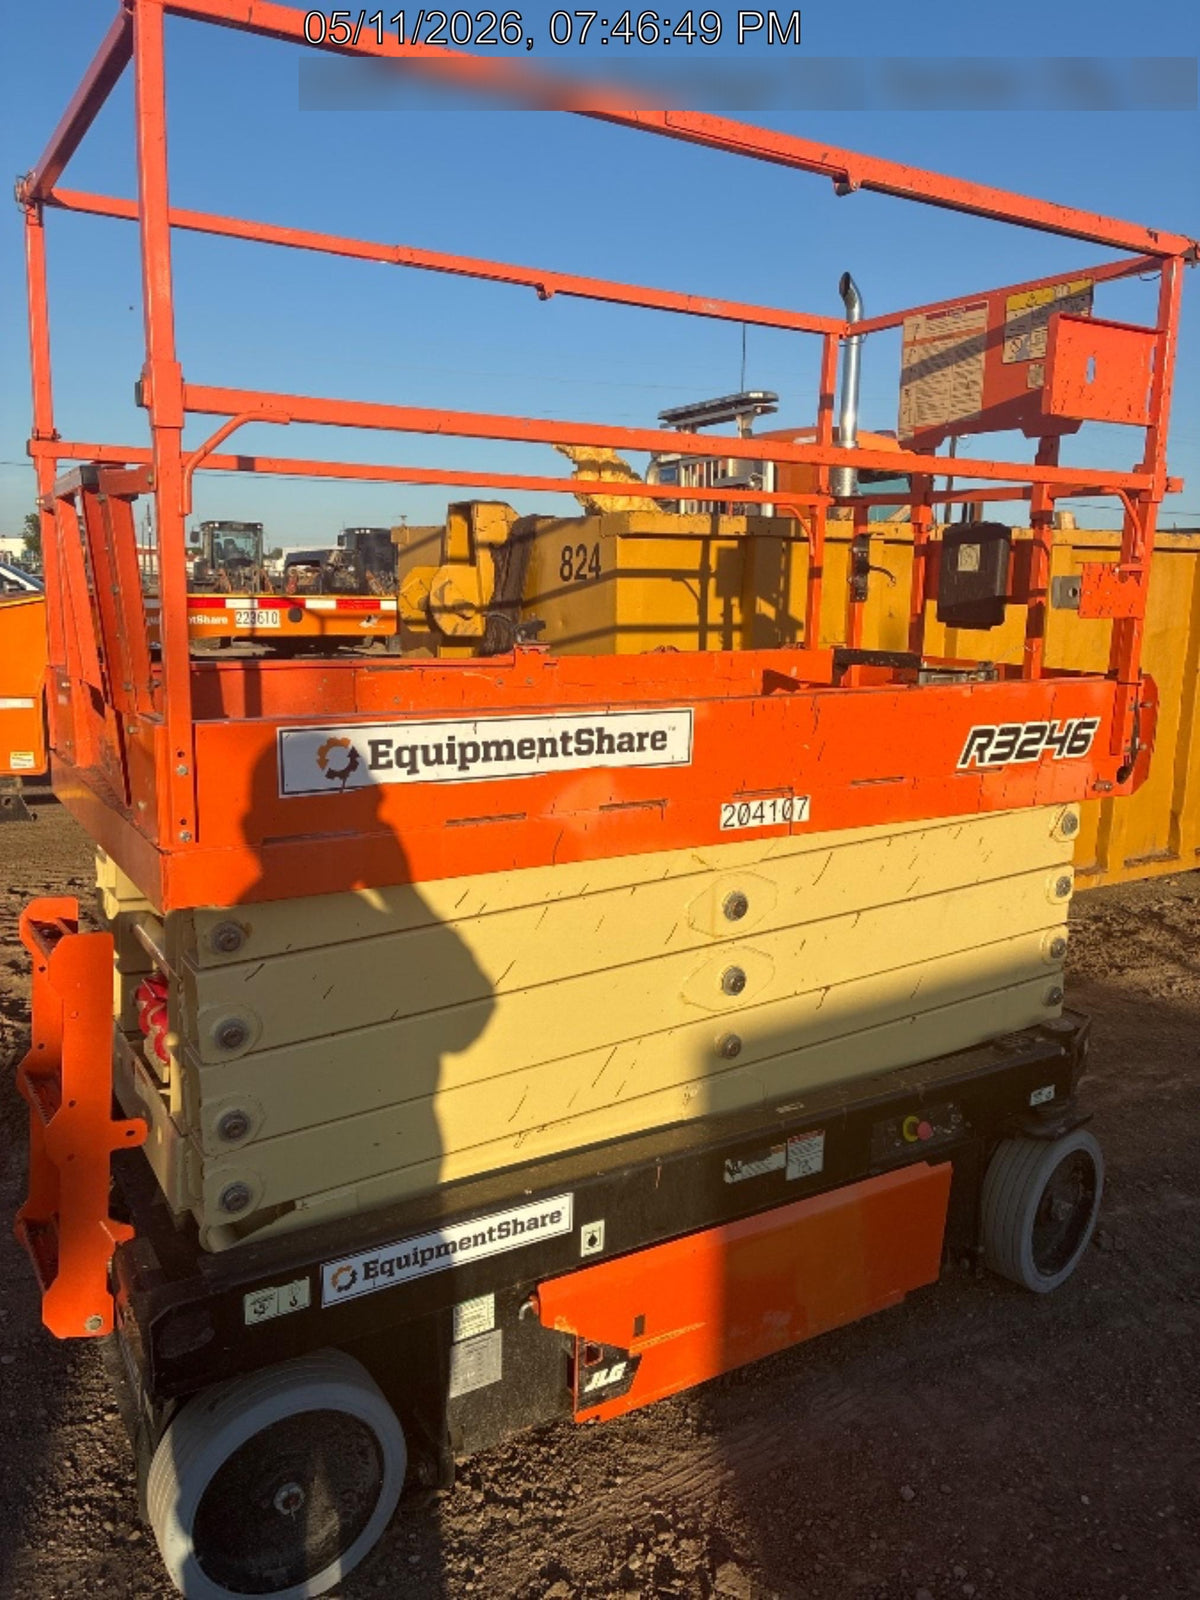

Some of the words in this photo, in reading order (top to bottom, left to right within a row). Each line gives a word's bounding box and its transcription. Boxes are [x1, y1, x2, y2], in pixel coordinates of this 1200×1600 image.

[560, 542, 602, 582] 824
[236, 610, 278, 625] 223610
[367, 727, 668, 776] EquipmentShare
[957, 717, 1101, 768] R3246
[723, 796, 808, 828] 204107
[362, 1209, 563, 1281] EquipmentShare
[584, 1361, 627, 1392] JLG
